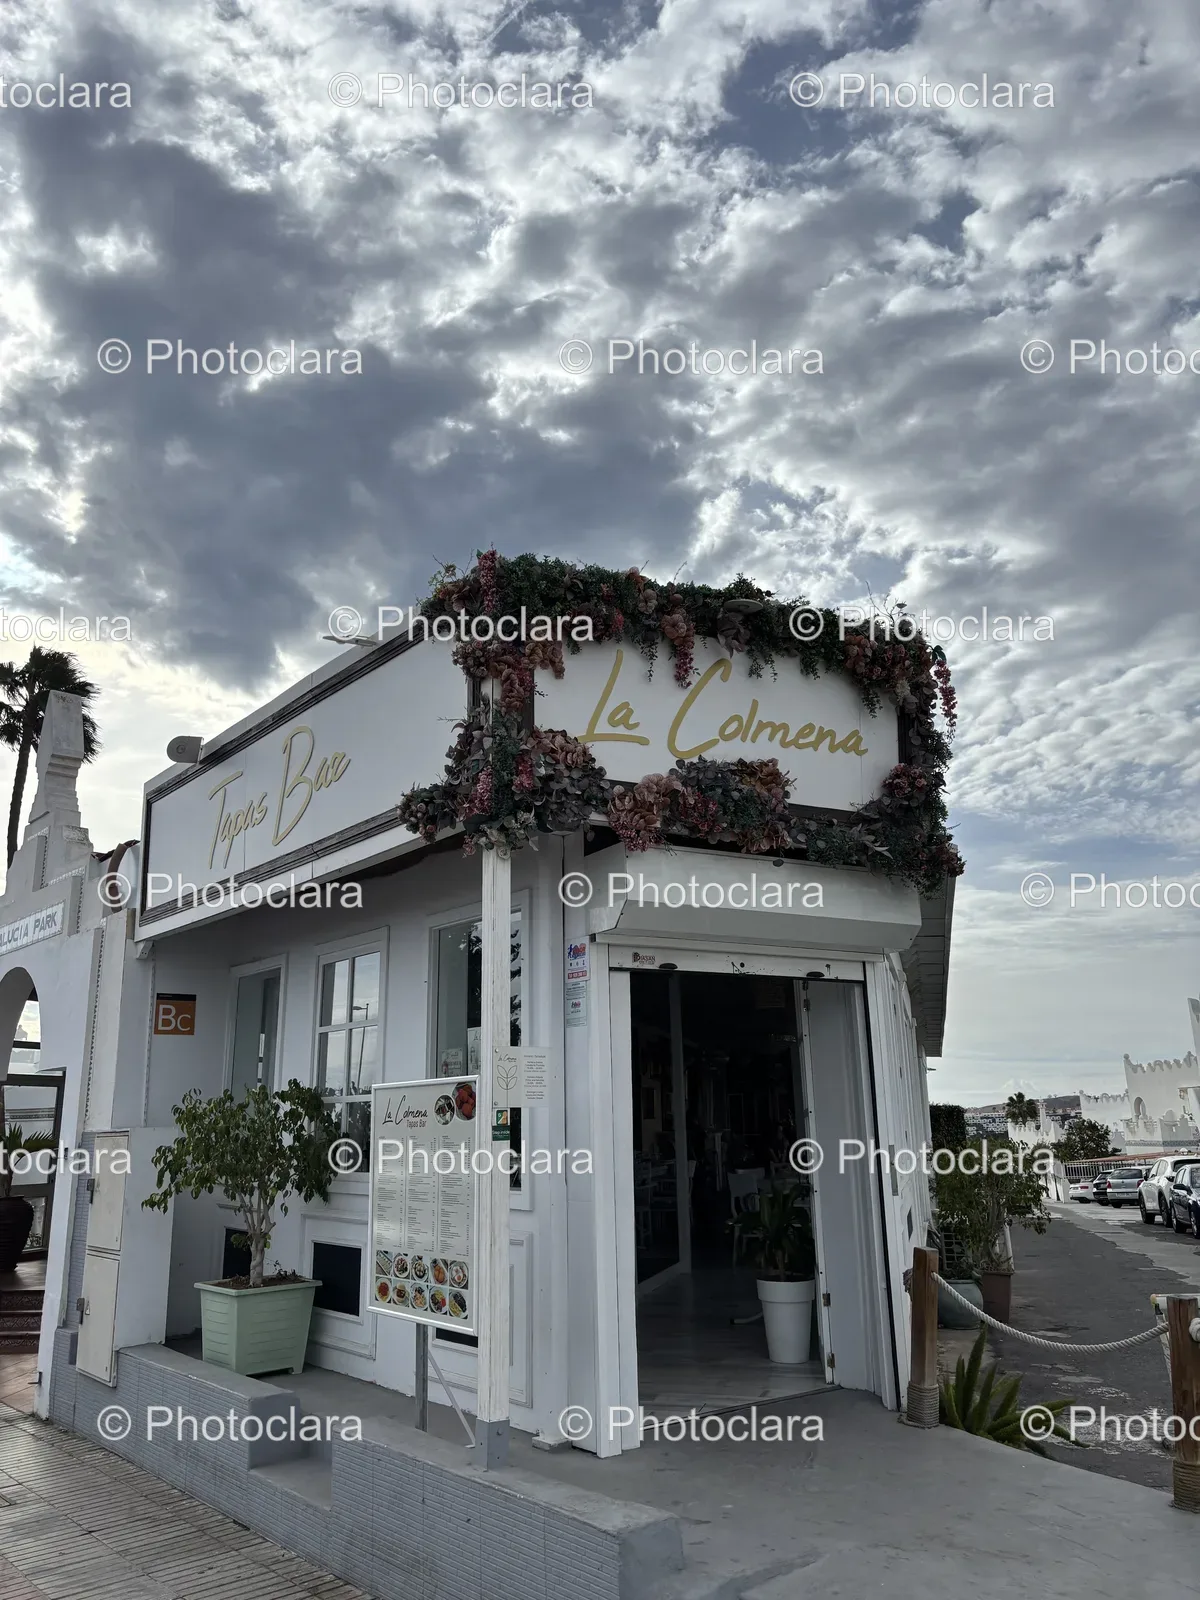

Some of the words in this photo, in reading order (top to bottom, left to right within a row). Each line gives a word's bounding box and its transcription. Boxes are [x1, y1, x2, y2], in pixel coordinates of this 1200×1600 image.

[577, 649, 650, 746] La
[667, 658, 869, 760] Colmena
[208, 770, 268, 870] Tapas
[272, 725, 352, 847] Bar
[33, 911, 58, 935] PARK
[157, 1004, 192, 1031] Bc
[382, 1097, 394, 1126] La
[395, 1094, 428, 1126] Colmena
[406, 1119, 419, 1130] Tapas
[419, 1118, 428, 1128] Bar
